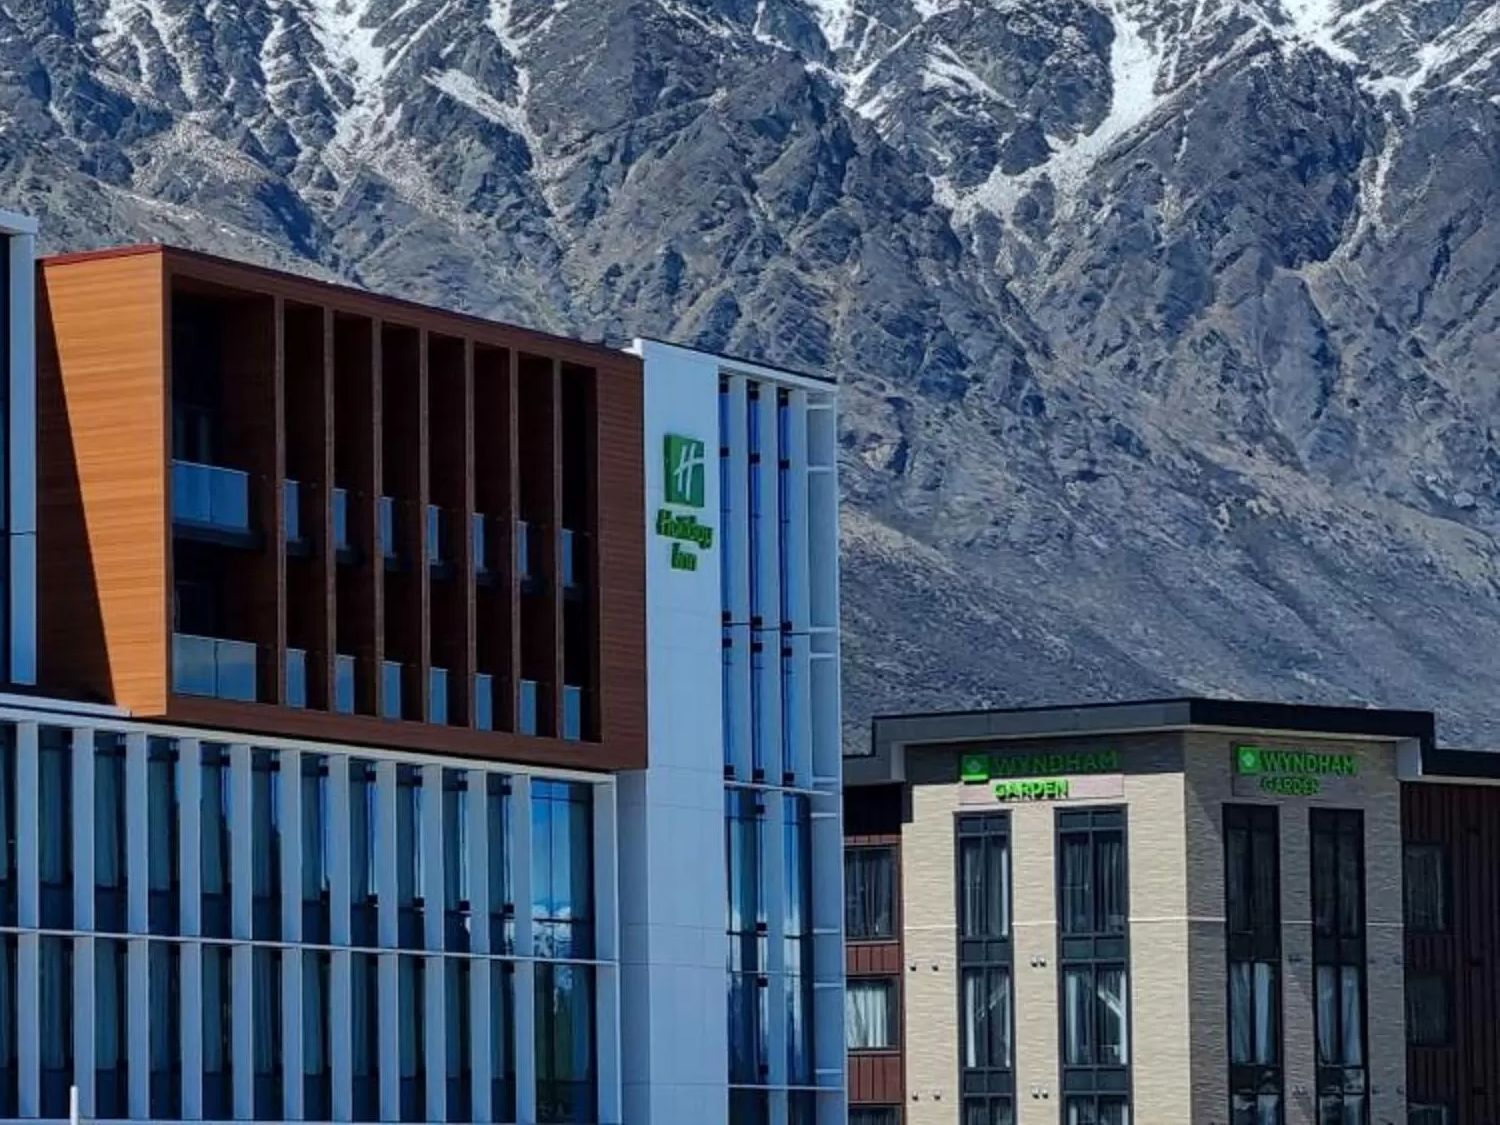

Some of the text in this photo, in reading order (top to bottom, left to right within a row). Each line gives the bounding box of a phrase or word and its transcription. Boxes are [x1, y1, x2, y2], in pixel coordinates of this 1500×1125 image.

[994, 748, 1118, 774] WYNDHAM
[1262, 750, 1358, 776] WYNDHAM
[993, 779, 1069, 798] GARDEN
[1260, 777, 1319, 795] GARDEN
